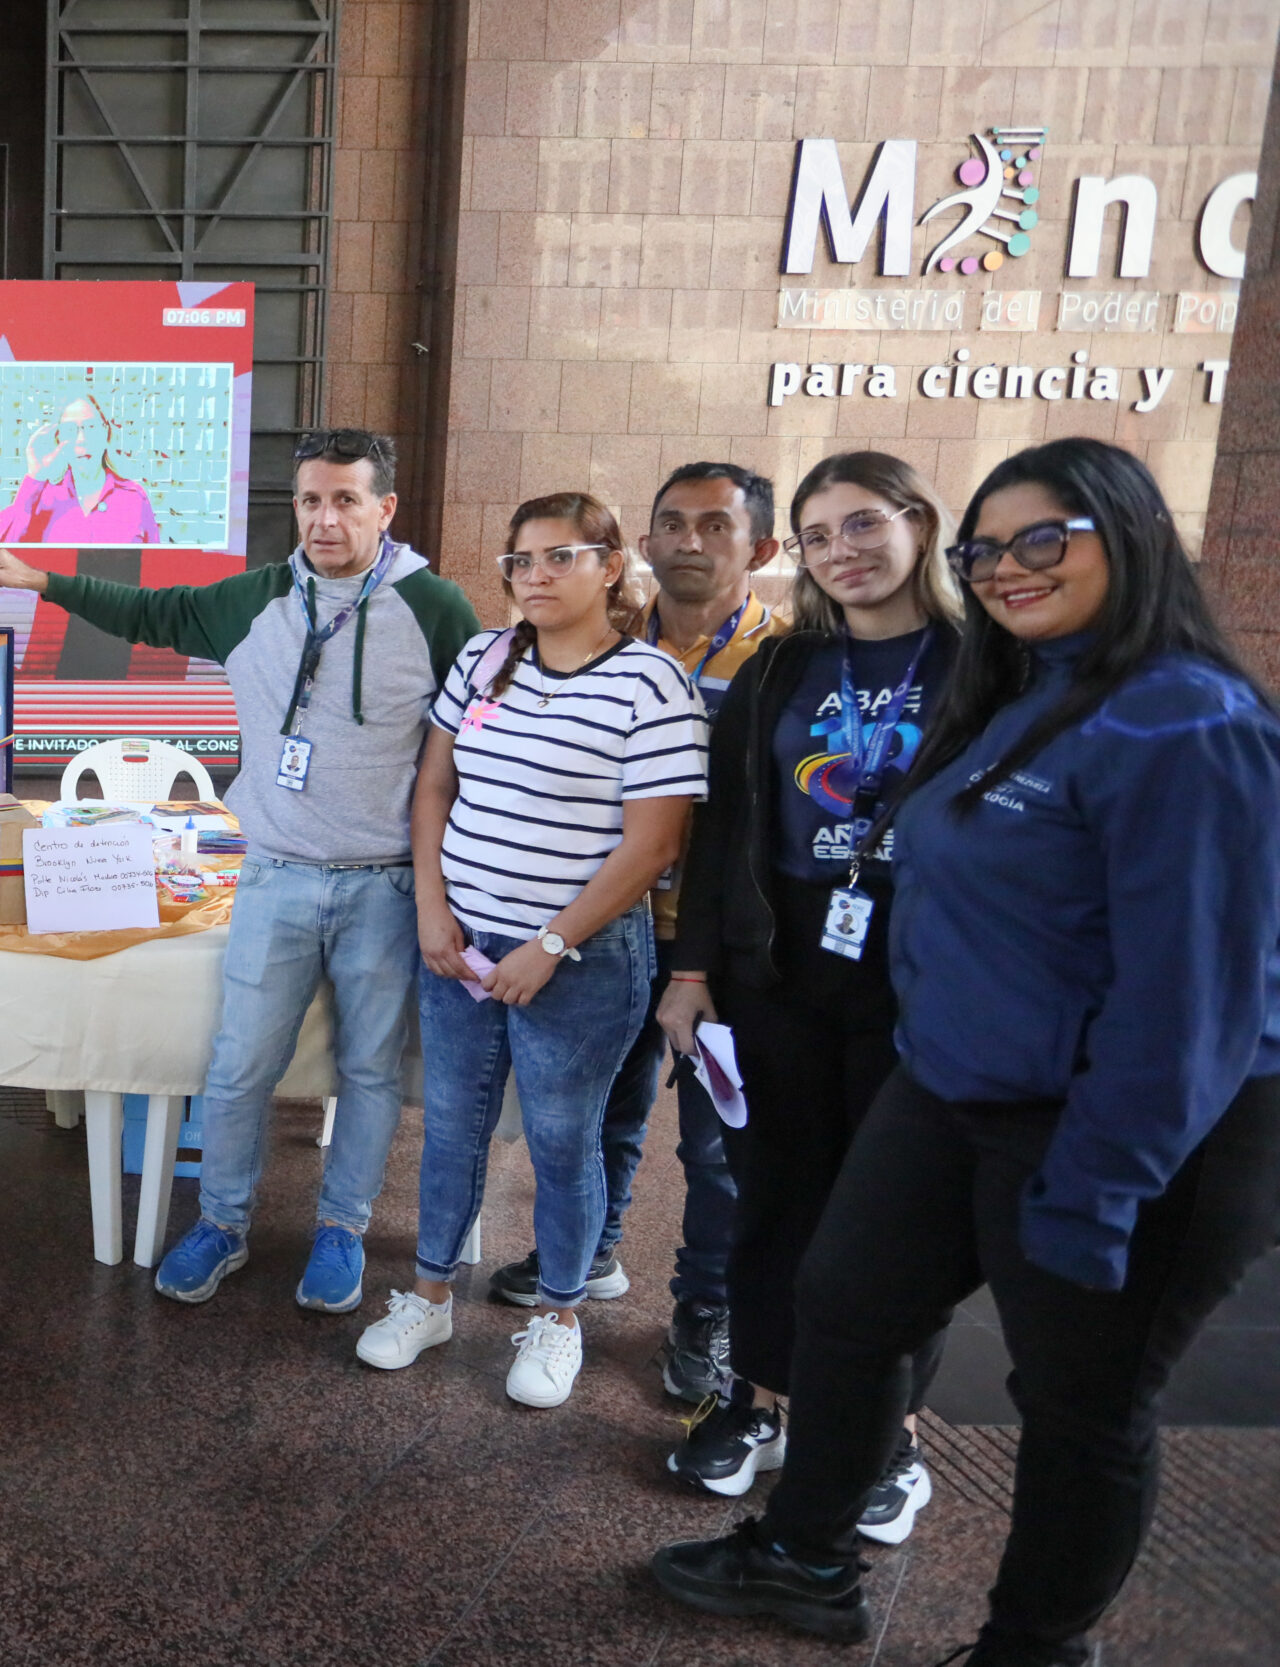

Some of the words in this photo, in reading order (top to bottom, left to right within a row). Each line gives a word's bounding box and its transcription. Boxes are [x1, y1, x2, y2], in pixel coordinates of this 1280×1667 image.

[781, 289, 962, 322] Ministerio
[985, 292, 1037, 324] del
[1060, 294, 1160, 325] Poder
[167, 310, 210, 325] 07:06
[215, 310, 241, 325] PM
[768, 361, 897, 407] para
[1131, 366, 1174, 412] y
[175, 739, 193, 751] AL
[196, 739, 239, 751] CONS
[33, 840, 69, 852] Centro
[74, 840, 84, 848] de
[34, 855, 77, 870] Brooklyn
